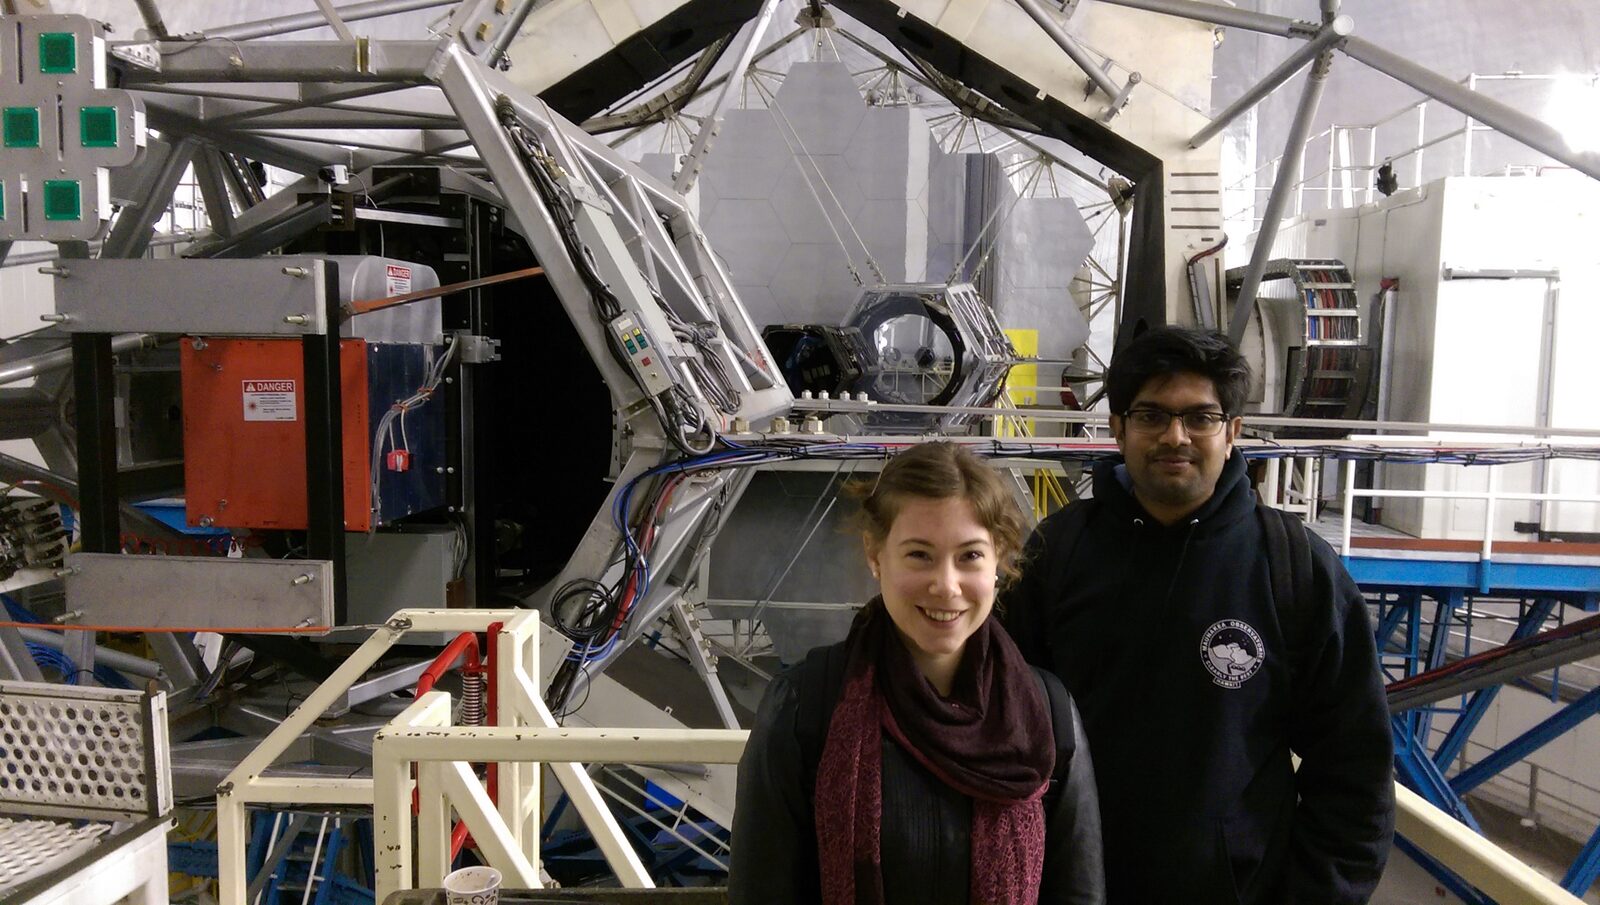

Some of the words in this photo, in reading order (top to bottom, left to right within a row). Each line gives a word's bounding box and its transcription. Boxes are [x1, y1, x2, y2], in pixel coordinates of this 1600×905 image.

[257, 382, 293, 391] DANGER
[1205, 660, 1227, 679] CLEARLY
[1240, 670, 1253, 680] BEST
